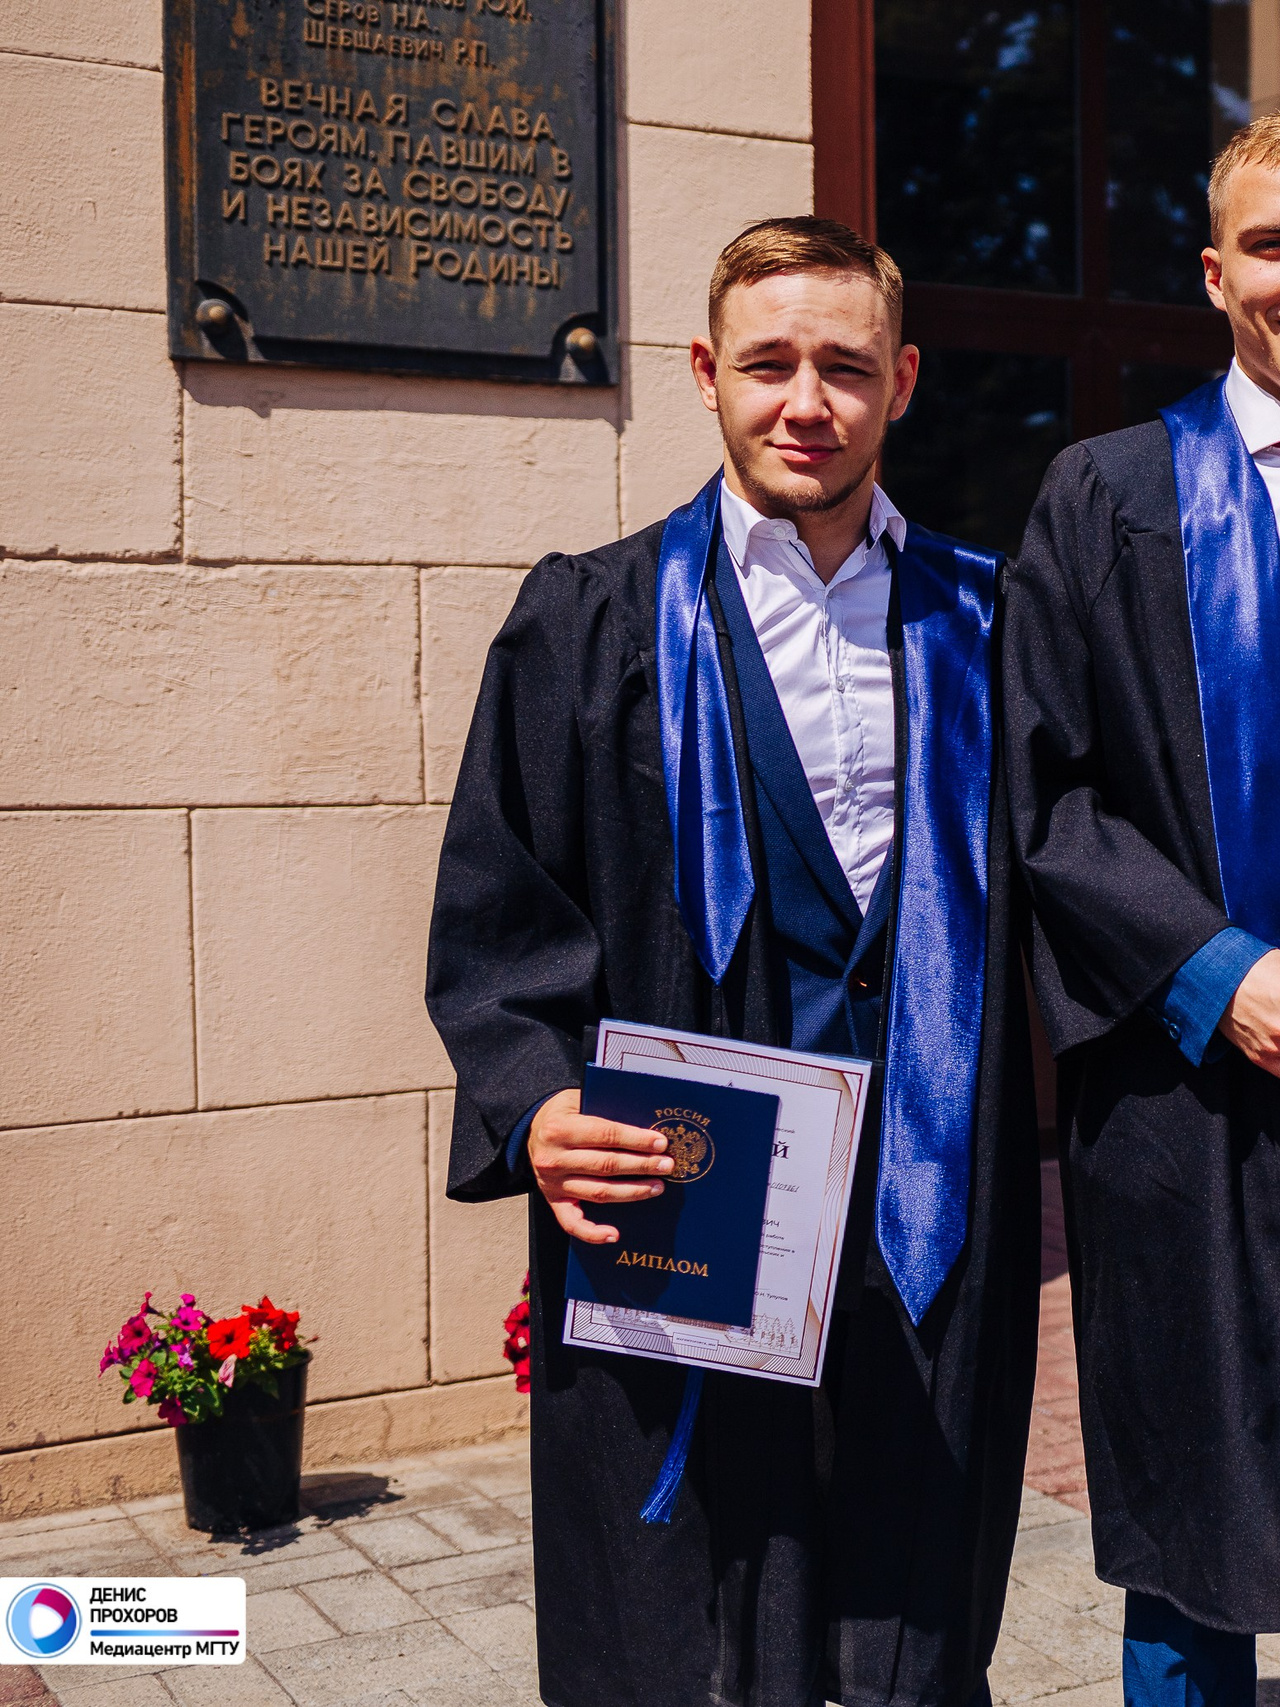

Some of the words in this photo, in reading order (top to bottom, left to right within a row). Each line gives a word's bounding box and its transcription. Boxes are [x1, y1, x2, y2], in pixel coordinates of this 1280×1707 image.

[260, 76, 410, 126] ВЕЧНАЯ
[432, 98, 555, 141] СЛАВА
[389, 130, 536, 177] ПАВШИМ
[553, 148, 572, 179] В
[229, 151, 325, 190] БОЯХ
[343, 163, 388, 198] ЗА
[403, 170, 573, 220] СВОБОДУ
[221, 188, 246, 223] И
[266, 194, 574, 253] НЕЗАВИСИМОСТЬ
[263, 233, 390, 275] НАШЕЙ
[410, 241, 561, 290] РОДИНЫ
[654, 1107, 712, 1127] РОССИЯ
[616, 1250, 709, 1278] ДИПЛОМ
